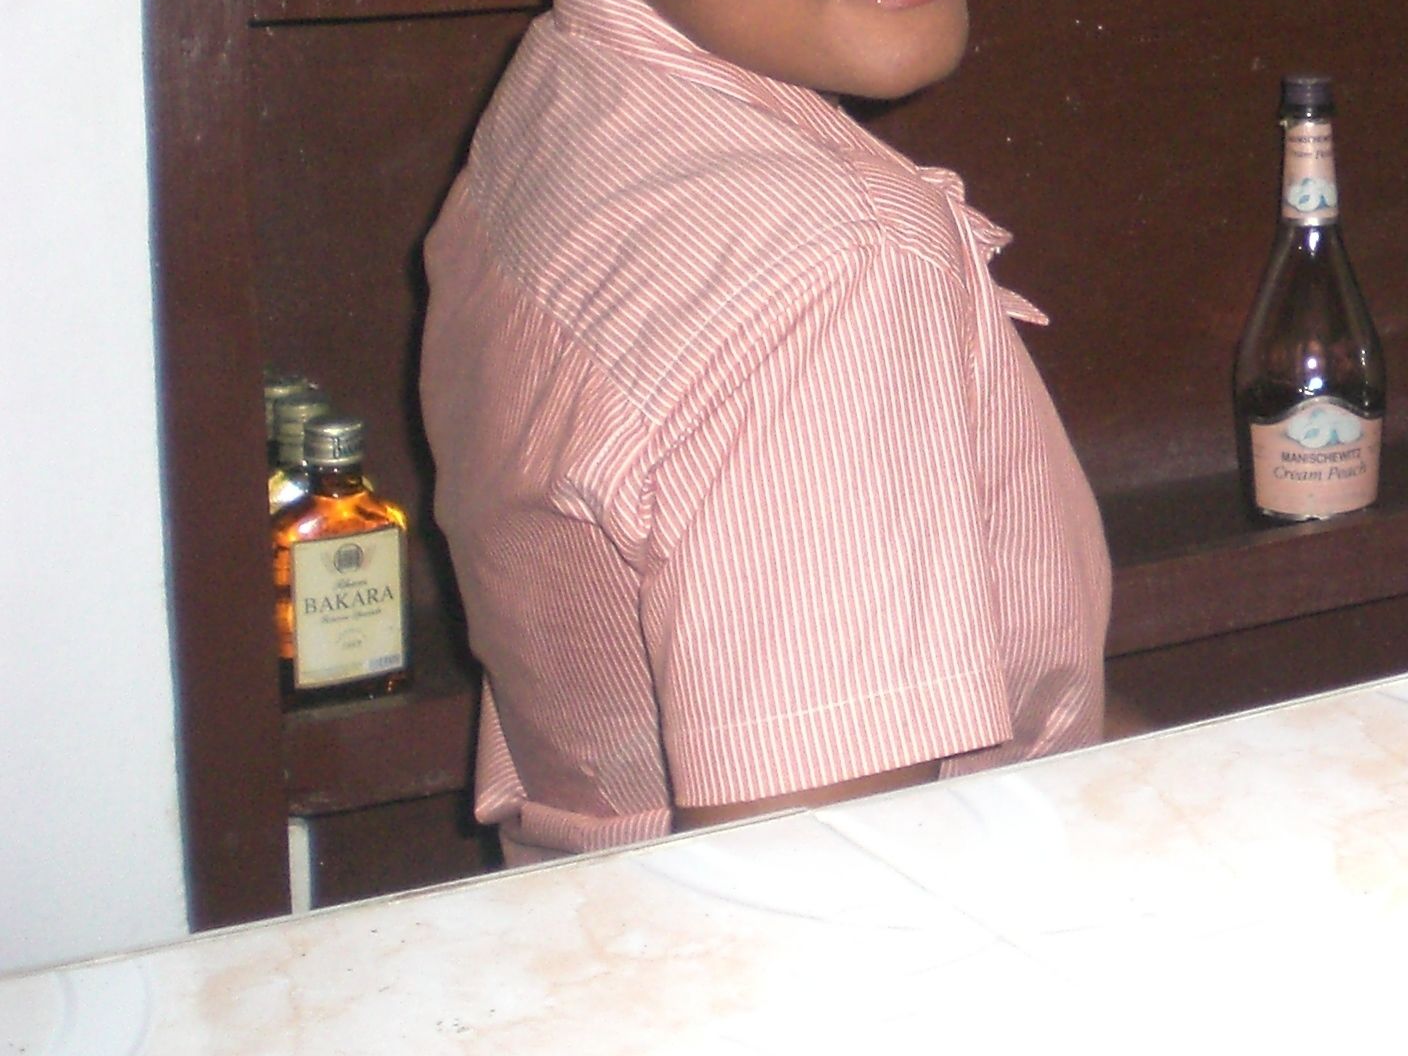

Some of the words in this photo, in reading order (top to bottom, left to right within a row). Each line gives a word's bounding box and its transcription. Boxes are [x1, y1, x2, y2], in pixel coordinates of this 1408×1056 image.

[1273, 465, 1322, 481] Cream
[1328, 460, 1366, 480] Peach
[304, 585, 394, 614] BAKARA
